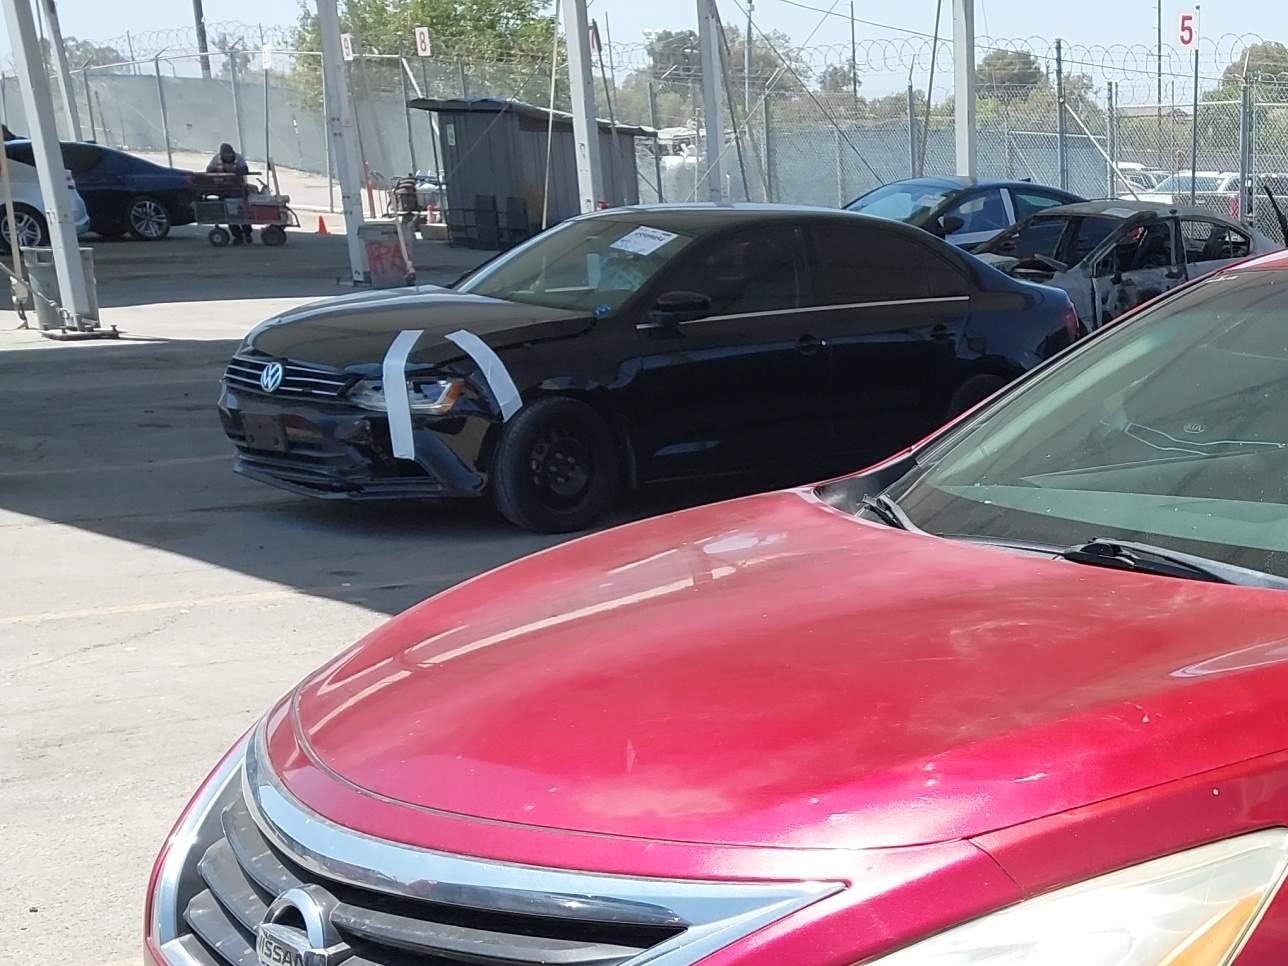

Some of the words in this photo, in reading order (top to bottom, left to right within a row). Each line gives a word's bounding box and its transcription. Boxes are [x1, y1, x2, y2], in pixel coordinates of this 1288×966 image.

[1180, 15, 1193, 45] 5
[343, 37, 350, 57] 9
[419, 31, 427, 52] 8
